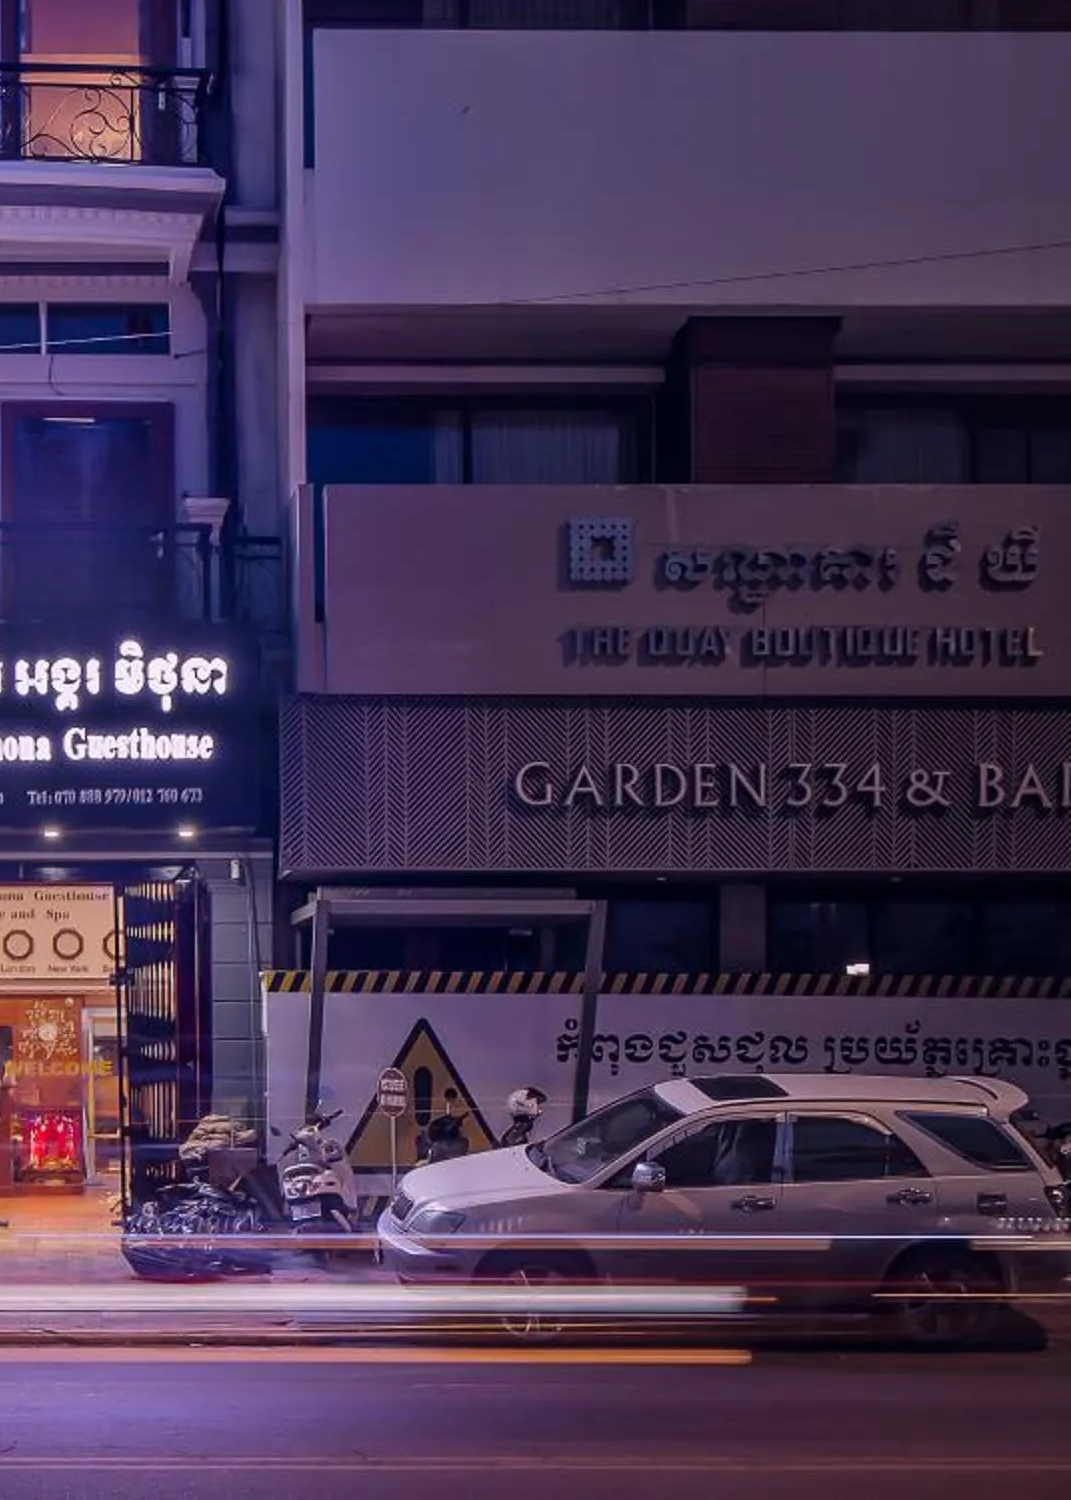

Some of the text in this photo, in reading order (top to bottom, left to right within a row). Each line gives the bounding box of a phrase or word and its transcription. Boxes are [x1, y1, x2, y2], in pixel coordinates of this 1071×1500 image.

[568, 625, 1044, 660] THE QUAY BOUTIQUE HOTEL
[62, 727, 214, 762] Guesthouse
[514, 760, 1071, 808] GARDEN 334 & BA
[34, 890, 110, 902] Guesthouse
[10, 907, 36, 920] and
[46, 907, 70, 922] Spa
[4, 1060, 113, 1077] WELCOME
